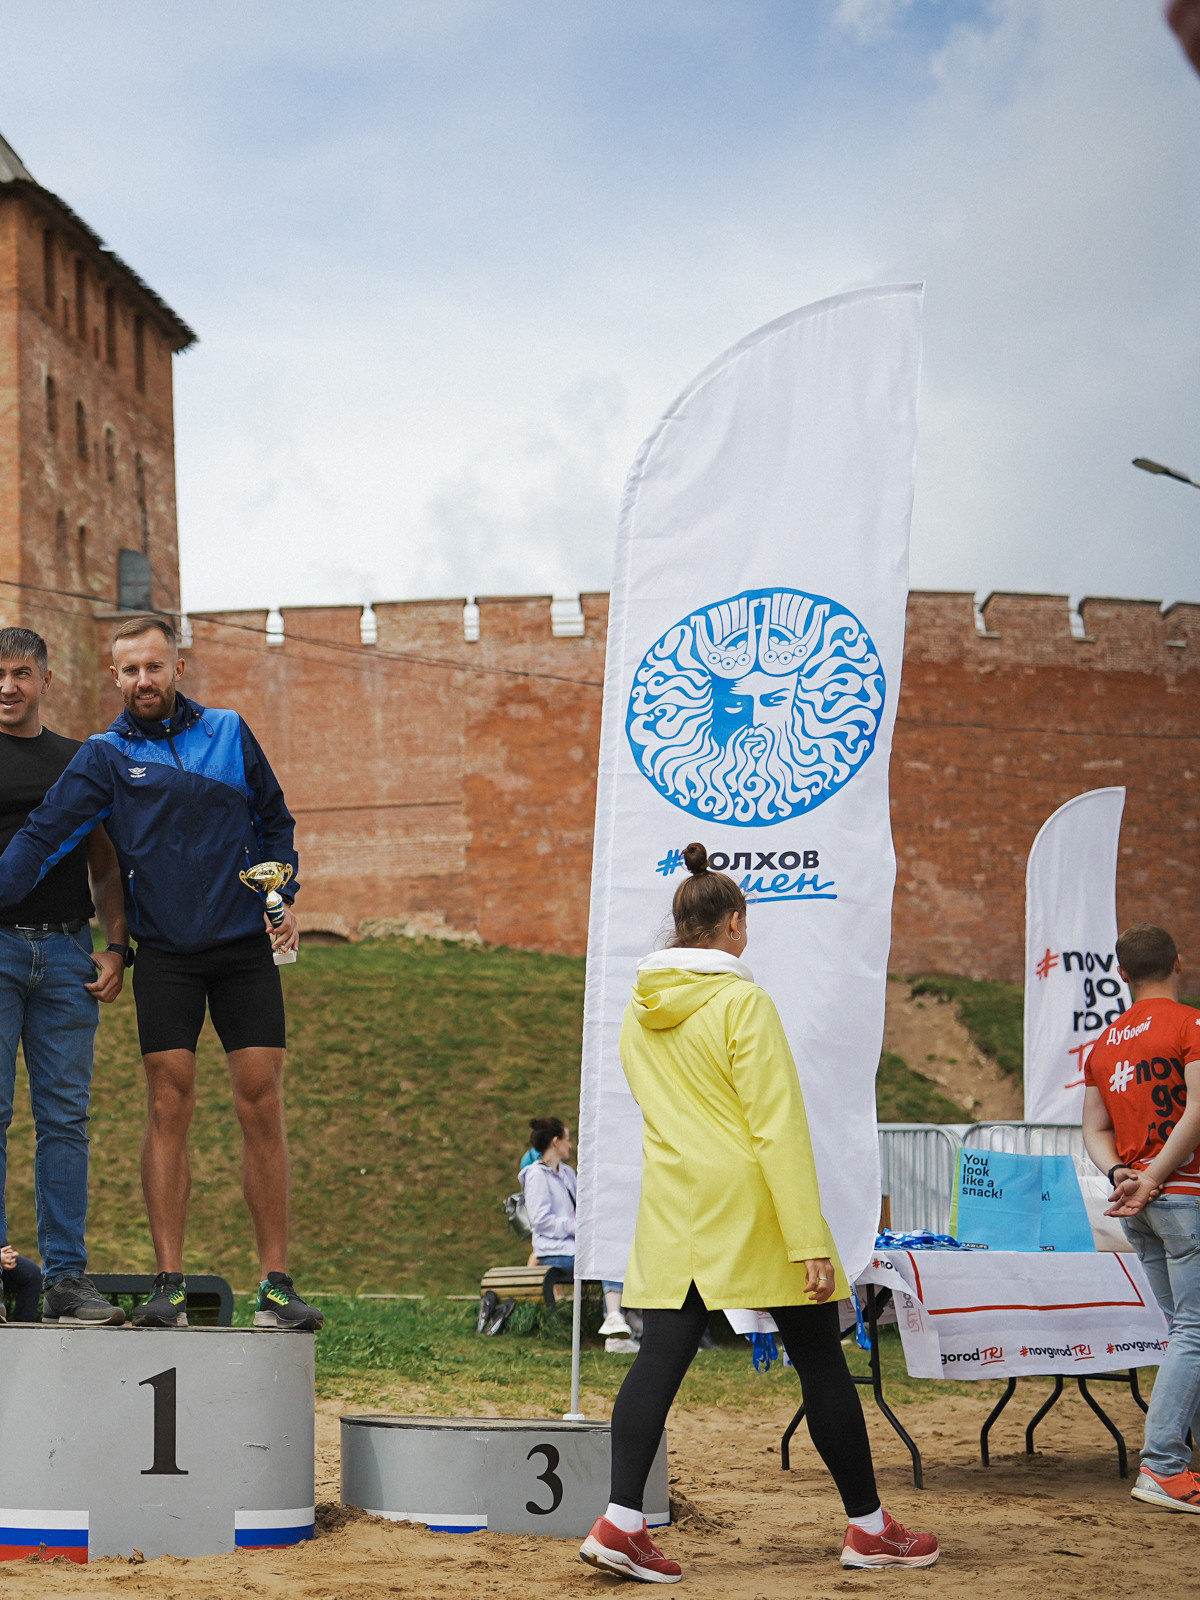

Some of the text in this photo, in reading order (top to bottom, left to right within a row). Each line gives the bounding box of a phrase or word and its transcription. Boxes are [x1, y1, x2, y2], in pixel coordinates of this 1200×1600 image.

[656, 848, 820, 876] #ОЛХОВ
[1035, 948, 1114, 981] #nov
[1083, 977, 1121, 1009] go
[1106, 1016, 1153, 1046] Дубовой
[1144, 1119, 1178, 1146] ro
[963, 1164, 990, 1177] look
[964, 1153, 989, 1167] You
[962, 1174, 994, 1188] like a
[962, 1186, 1003, 1199] snack!
[1019, 1344, 1093, 1359] #novgorodTRI
[1106, 1339, 1169, 1355] #novgorodT
[138, 1366, 189, 1475] 1
[525, 1443, 564, 1515] 3
